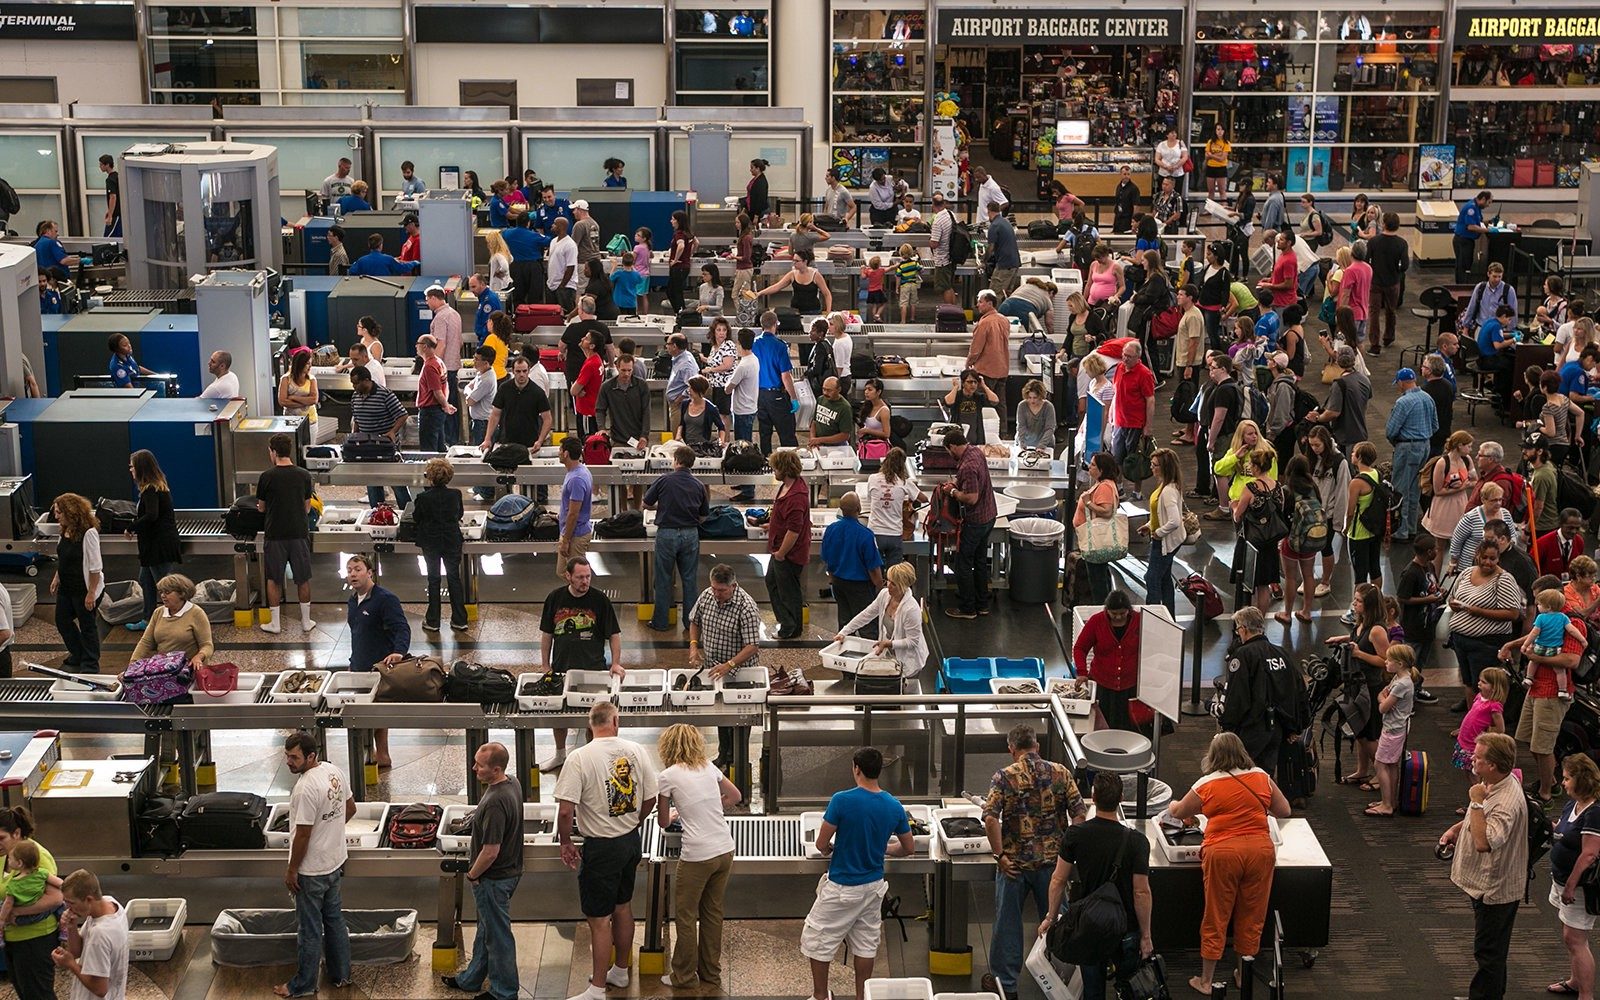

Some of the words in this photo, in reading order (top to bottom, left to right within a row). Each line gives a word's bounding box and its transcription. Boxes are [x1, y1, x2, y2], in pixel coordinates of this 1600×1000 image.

[0, 15, 76, 26] TERMINAL
[951, 18, 1023, 37] AIRPORT
[1027, 18, 1099, 37] BAGGAGE
[1104, 18, 1169, 37] CENTER
[1468, 17, 1541, 37] AIRPORT
[815, 413, 831, 426] STATE
[1266, 657, 1287, 671] TSA
